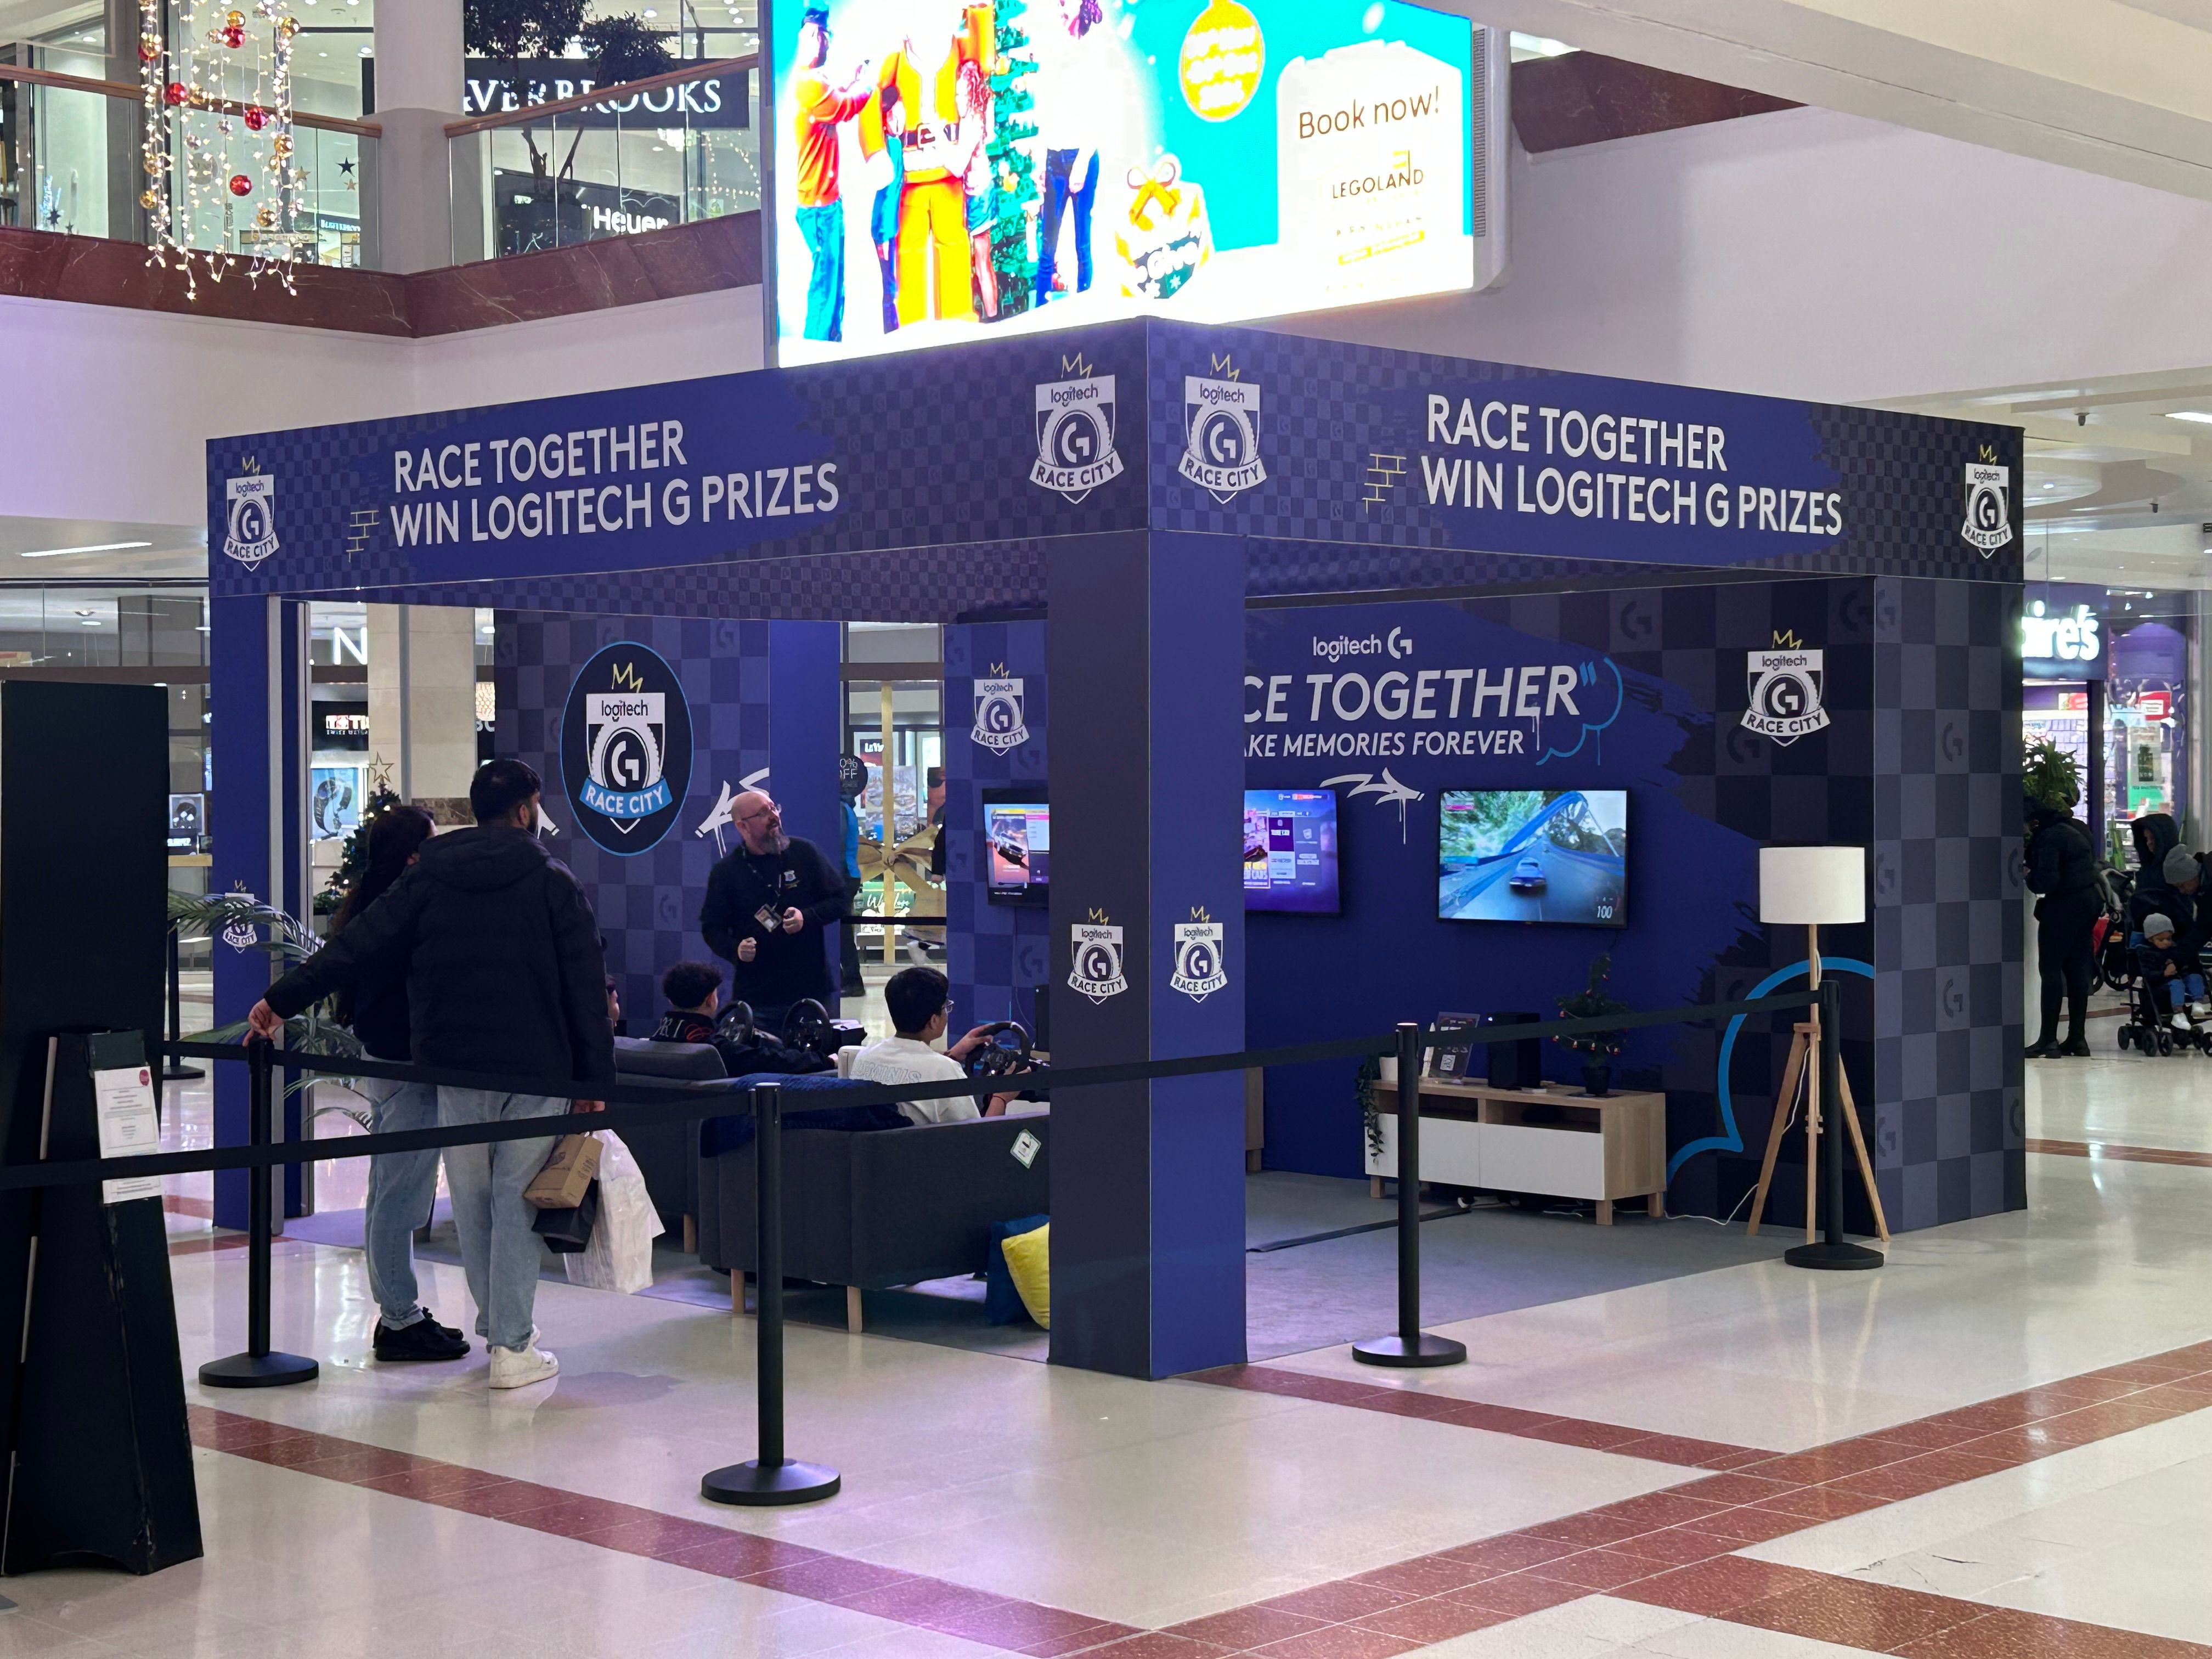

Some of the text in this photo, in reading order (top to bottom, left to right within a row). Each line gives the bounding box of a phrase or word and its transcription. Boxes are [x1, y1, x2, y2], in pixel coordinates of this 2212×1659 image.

[1300, 86, 1438, 139] Book now!
[1333, 150, 1424, 199] LEGOLAND
[593, 206, 668, 234] Heuer
[1051, 383, 1098, 406] logitech
[1200, 383, 1245, 405] logitech
[1427, 394, 1728, 472] RACE TOGETHER
[395, 420, 687, 493] RACE TOGETHER
[1036, 456, 1115, 488] RACE CITY
[1184, 456, 1260, 488] RACE CITY
[236, 480, 264, 497] logitech
[1421, 456, 1842, 537] WIN LOGITECH G PRIZES
[390, 462, 839, 547] WIN LOGITECH G PRIZES
[1965, 524, 2008, 546] RACE CITY
[227, 539, 275, 559] RACE CITY
[1313, 626, 1413, 663] logitech G
[1762, 654, 1807, 671] logitech
[601, 700, 648, 722] logitech
[1746, 712, 1822, 733] RACE CITY
[974, 730, 1025, 746] RACE CITY
[1283, 731, 1406, 756] MEMORIES
[1413, 730, 1525, 756] FOREVER
[586, 785, 663, 814] RACE CITY
[1597, 905, 1612, 918] 100
[1081, 928, 1113, 941] logitech
[1071, 978, 1122, 994] RACE CITY
[1175, 975, 1223, 992] RACE CITY
